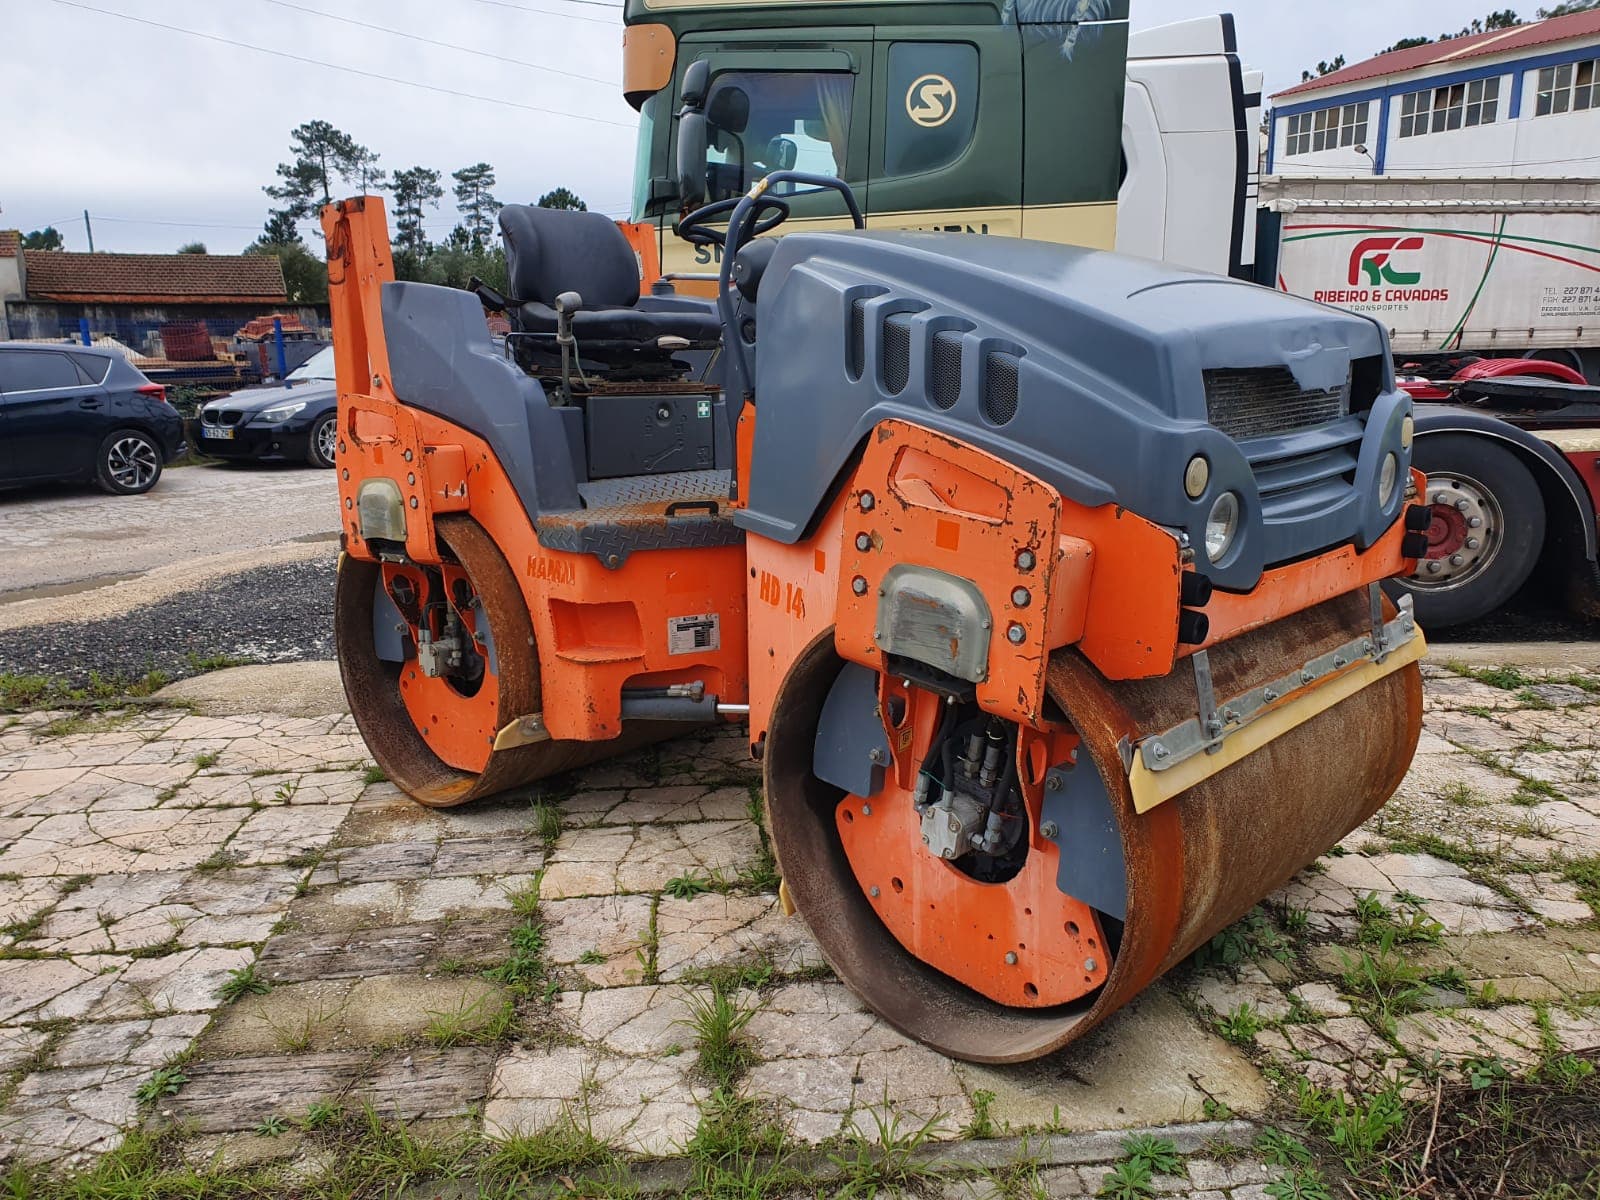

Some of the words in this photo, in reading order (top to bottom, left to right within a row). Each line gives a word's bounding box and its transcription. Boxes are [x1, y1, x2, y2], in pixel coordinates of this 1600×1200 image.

[1563, 286, 1579, 295] 227
[1580, 286, 1593, 295] 871
[1314, 290, 1369, 303] RIBEIRO
[1372, 290, 1382, 302] &
[1385, 289, 1449, 302] CAVADAS
[1561, 296, 1577, 304] 227
[1579, 296, 1591, 304] 871
[1350, 304, 1409, 312] TRANSPORTES
[760, 570, 781, 607] HD
[786, 582, 803, 620] 14
